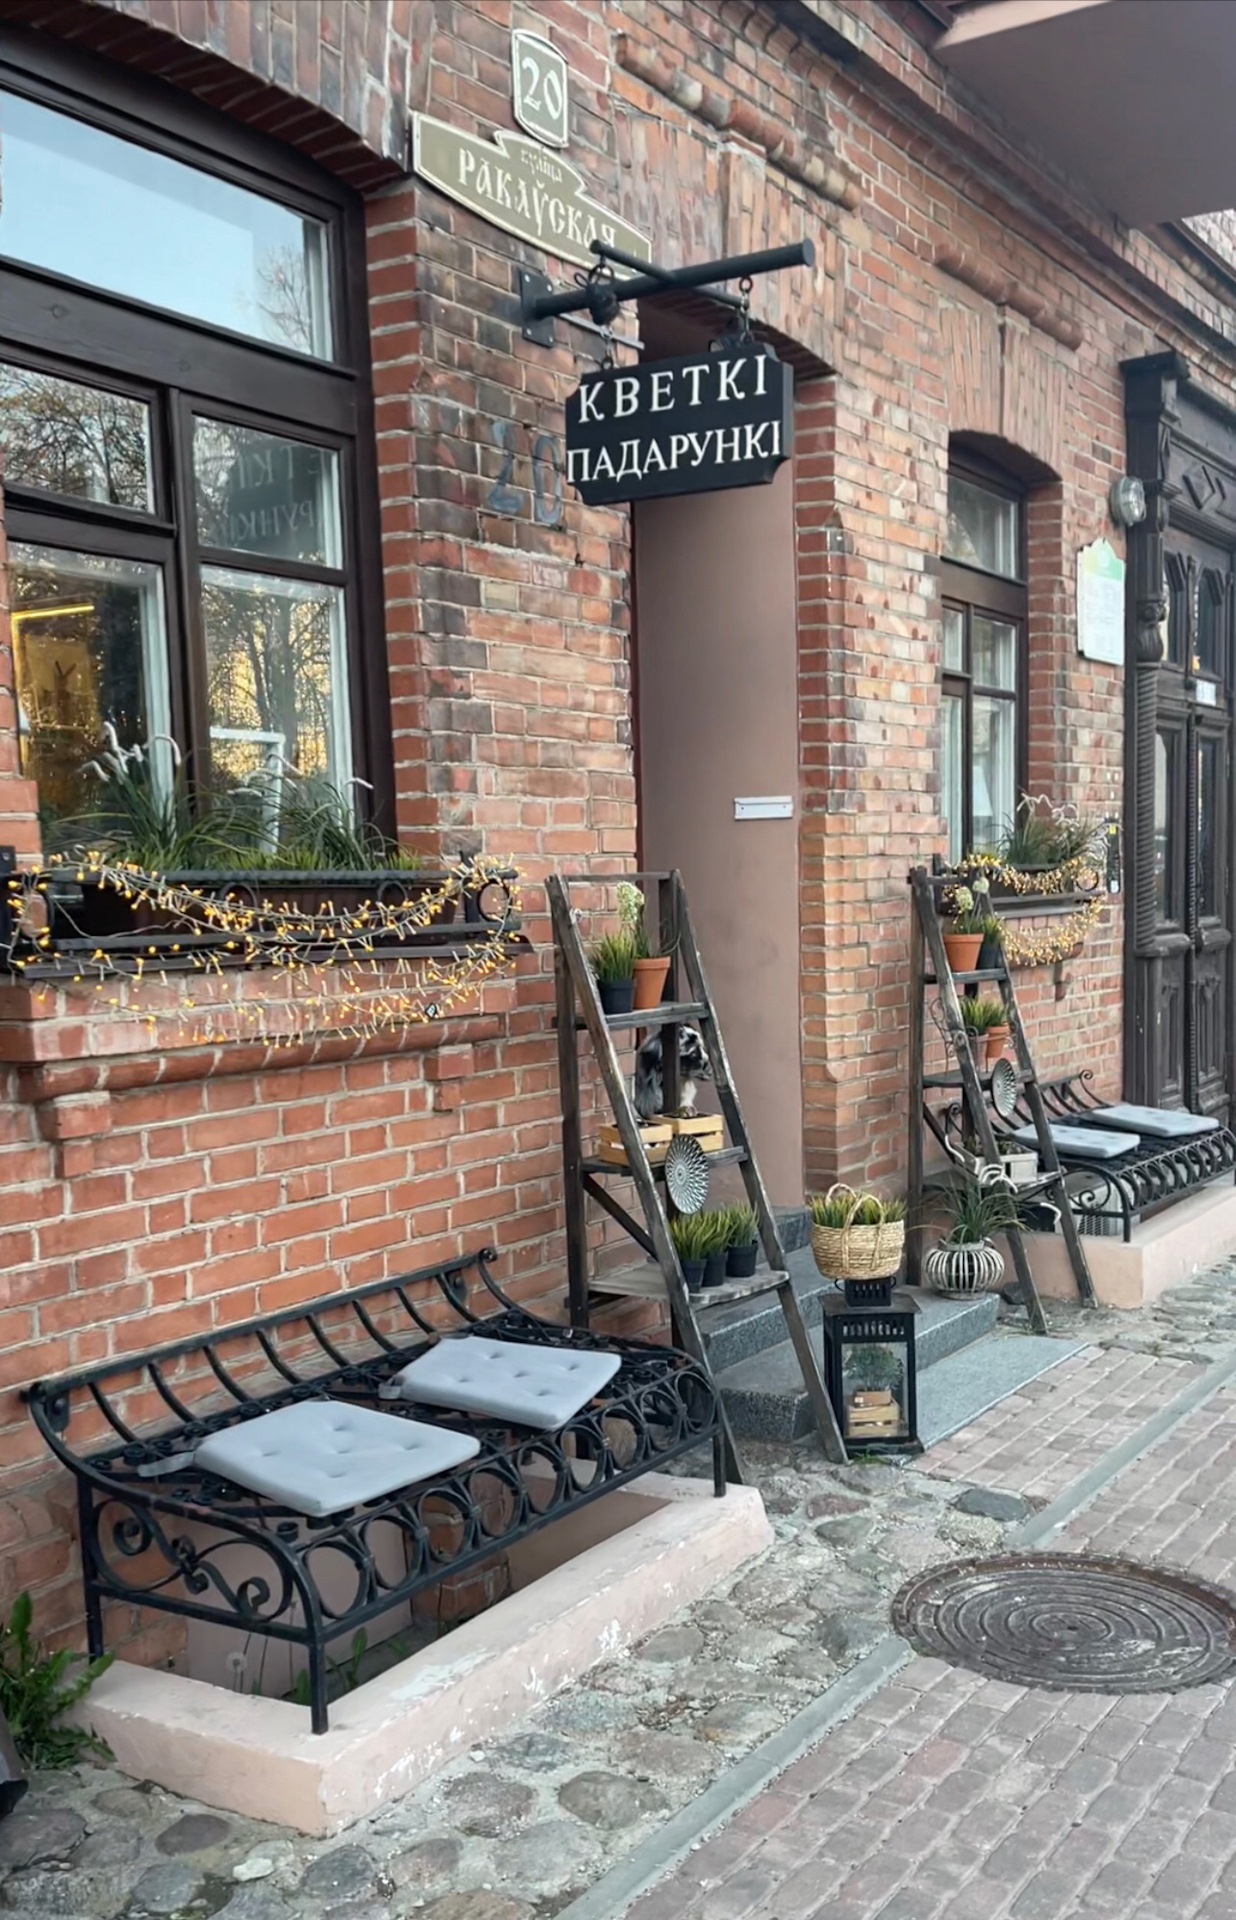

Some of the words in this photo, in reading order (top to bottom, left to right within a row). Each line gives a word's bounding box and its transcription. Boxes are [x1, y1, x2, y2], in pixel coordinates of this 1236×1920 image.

[522, 57, 563, 120] 20
[578, 354, 767, 424] КВЕТКІ
[487, 419, 562, 525] 20
[566, 420, 781, 483] ПАДАРУНКІ
